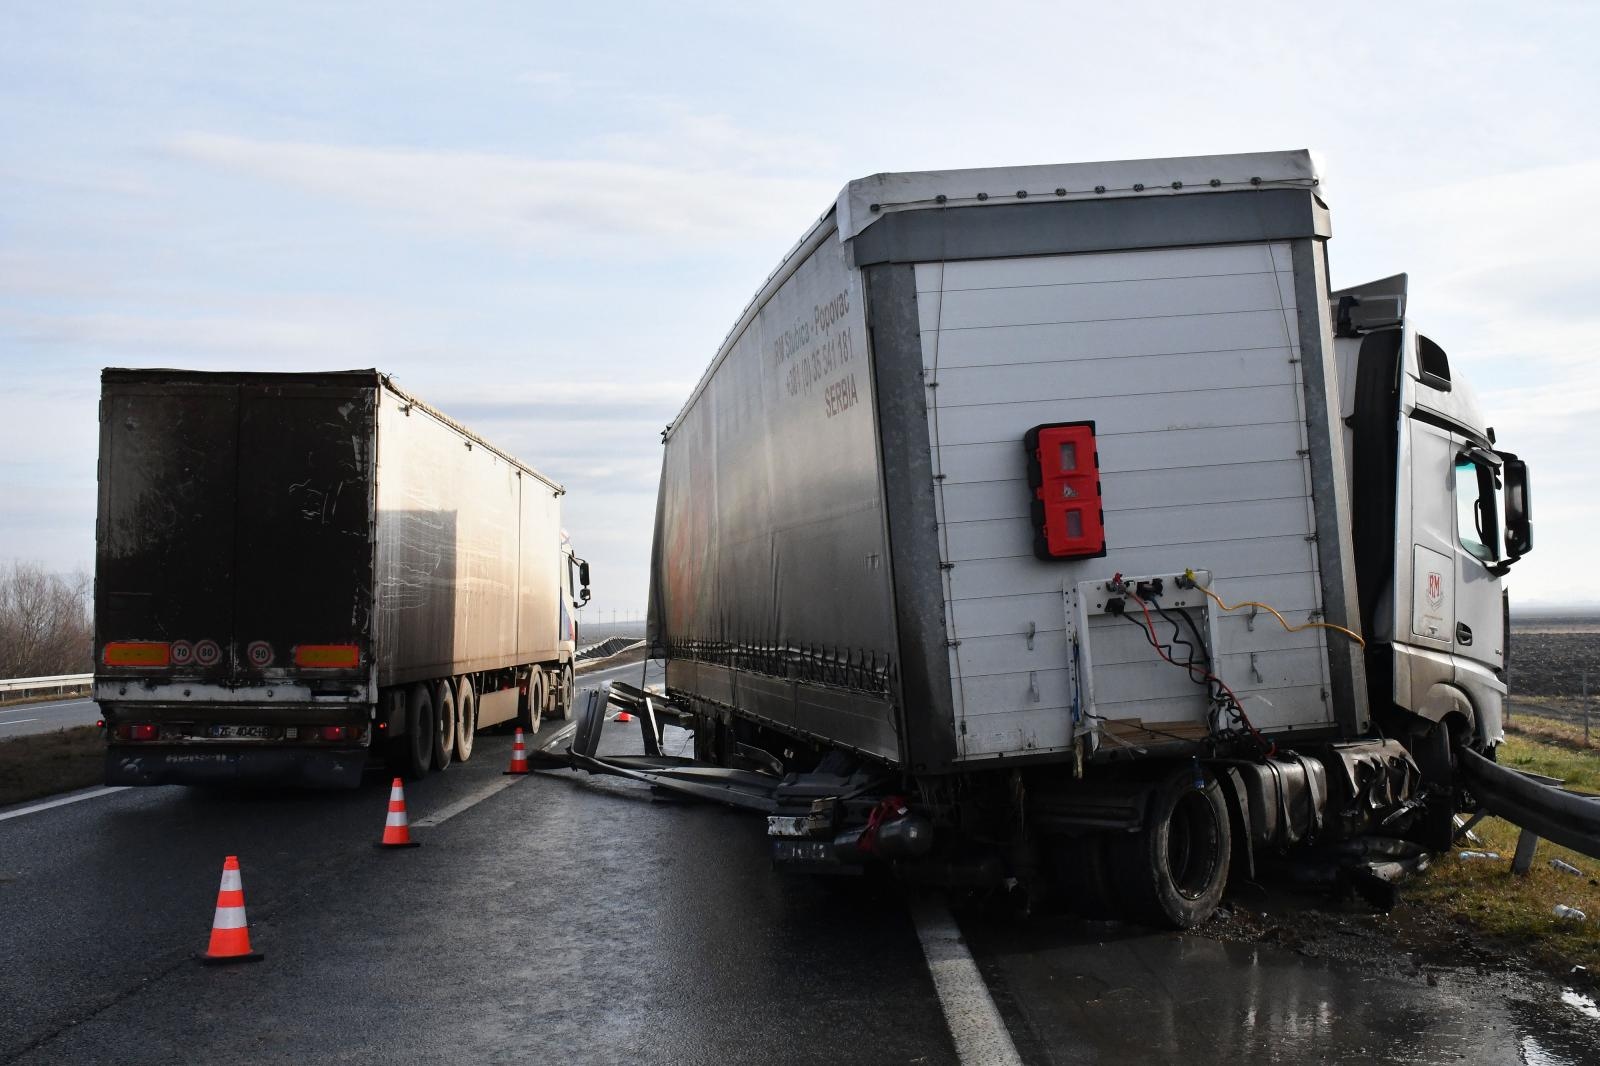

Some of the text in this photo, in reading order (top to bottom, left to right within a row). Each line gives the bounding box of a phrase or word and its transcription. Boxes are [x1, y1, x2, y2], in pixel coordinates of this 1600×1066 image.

[814, 289, 849, 336] Popovac
[837, 327, 854, 365] 181
[824, 373, 859, 418] SERBIA
[1428, 574, 1440, 599] RM
[176, 648, 187, 657] 70
[255, 649, 266, 659] 90
